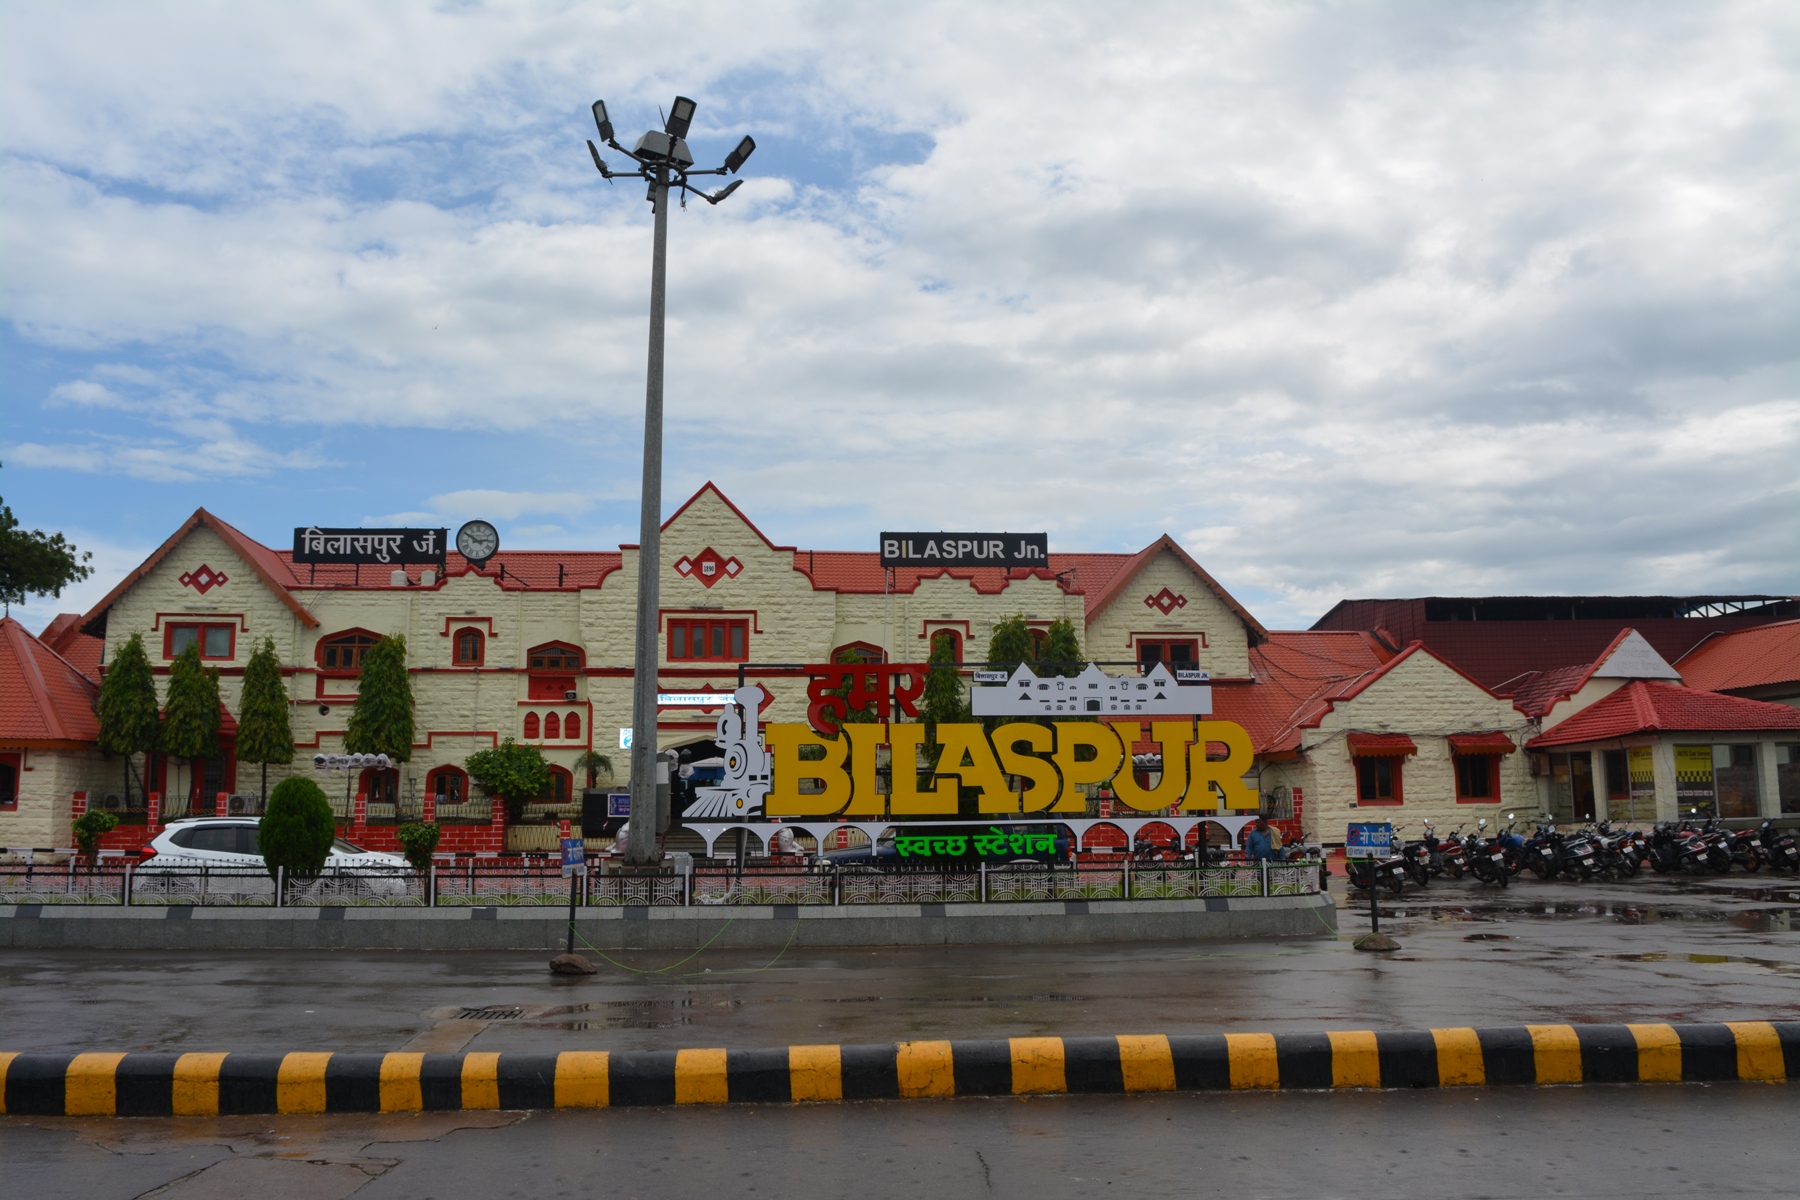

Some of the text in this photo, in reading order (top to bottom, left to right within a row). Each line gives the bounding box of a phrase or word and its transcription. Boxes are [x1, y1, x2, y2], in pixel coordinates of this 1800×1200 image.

[301, 527, 440, 563] बिलासपुर जं.
[884, 539, 1045, 559] BILASPUR Jn.
[975, 671, 998, 681] बिलासपुर
[659, 693, 713, 704] बिलासपुर
[804, 663, 930, 735] हमर
[765, 721, 1259, 816] BILASPUR
[894, 826, 1057, 857] स्वच्छ स्टेशन
[1360, 826, 1370, 845] नो
